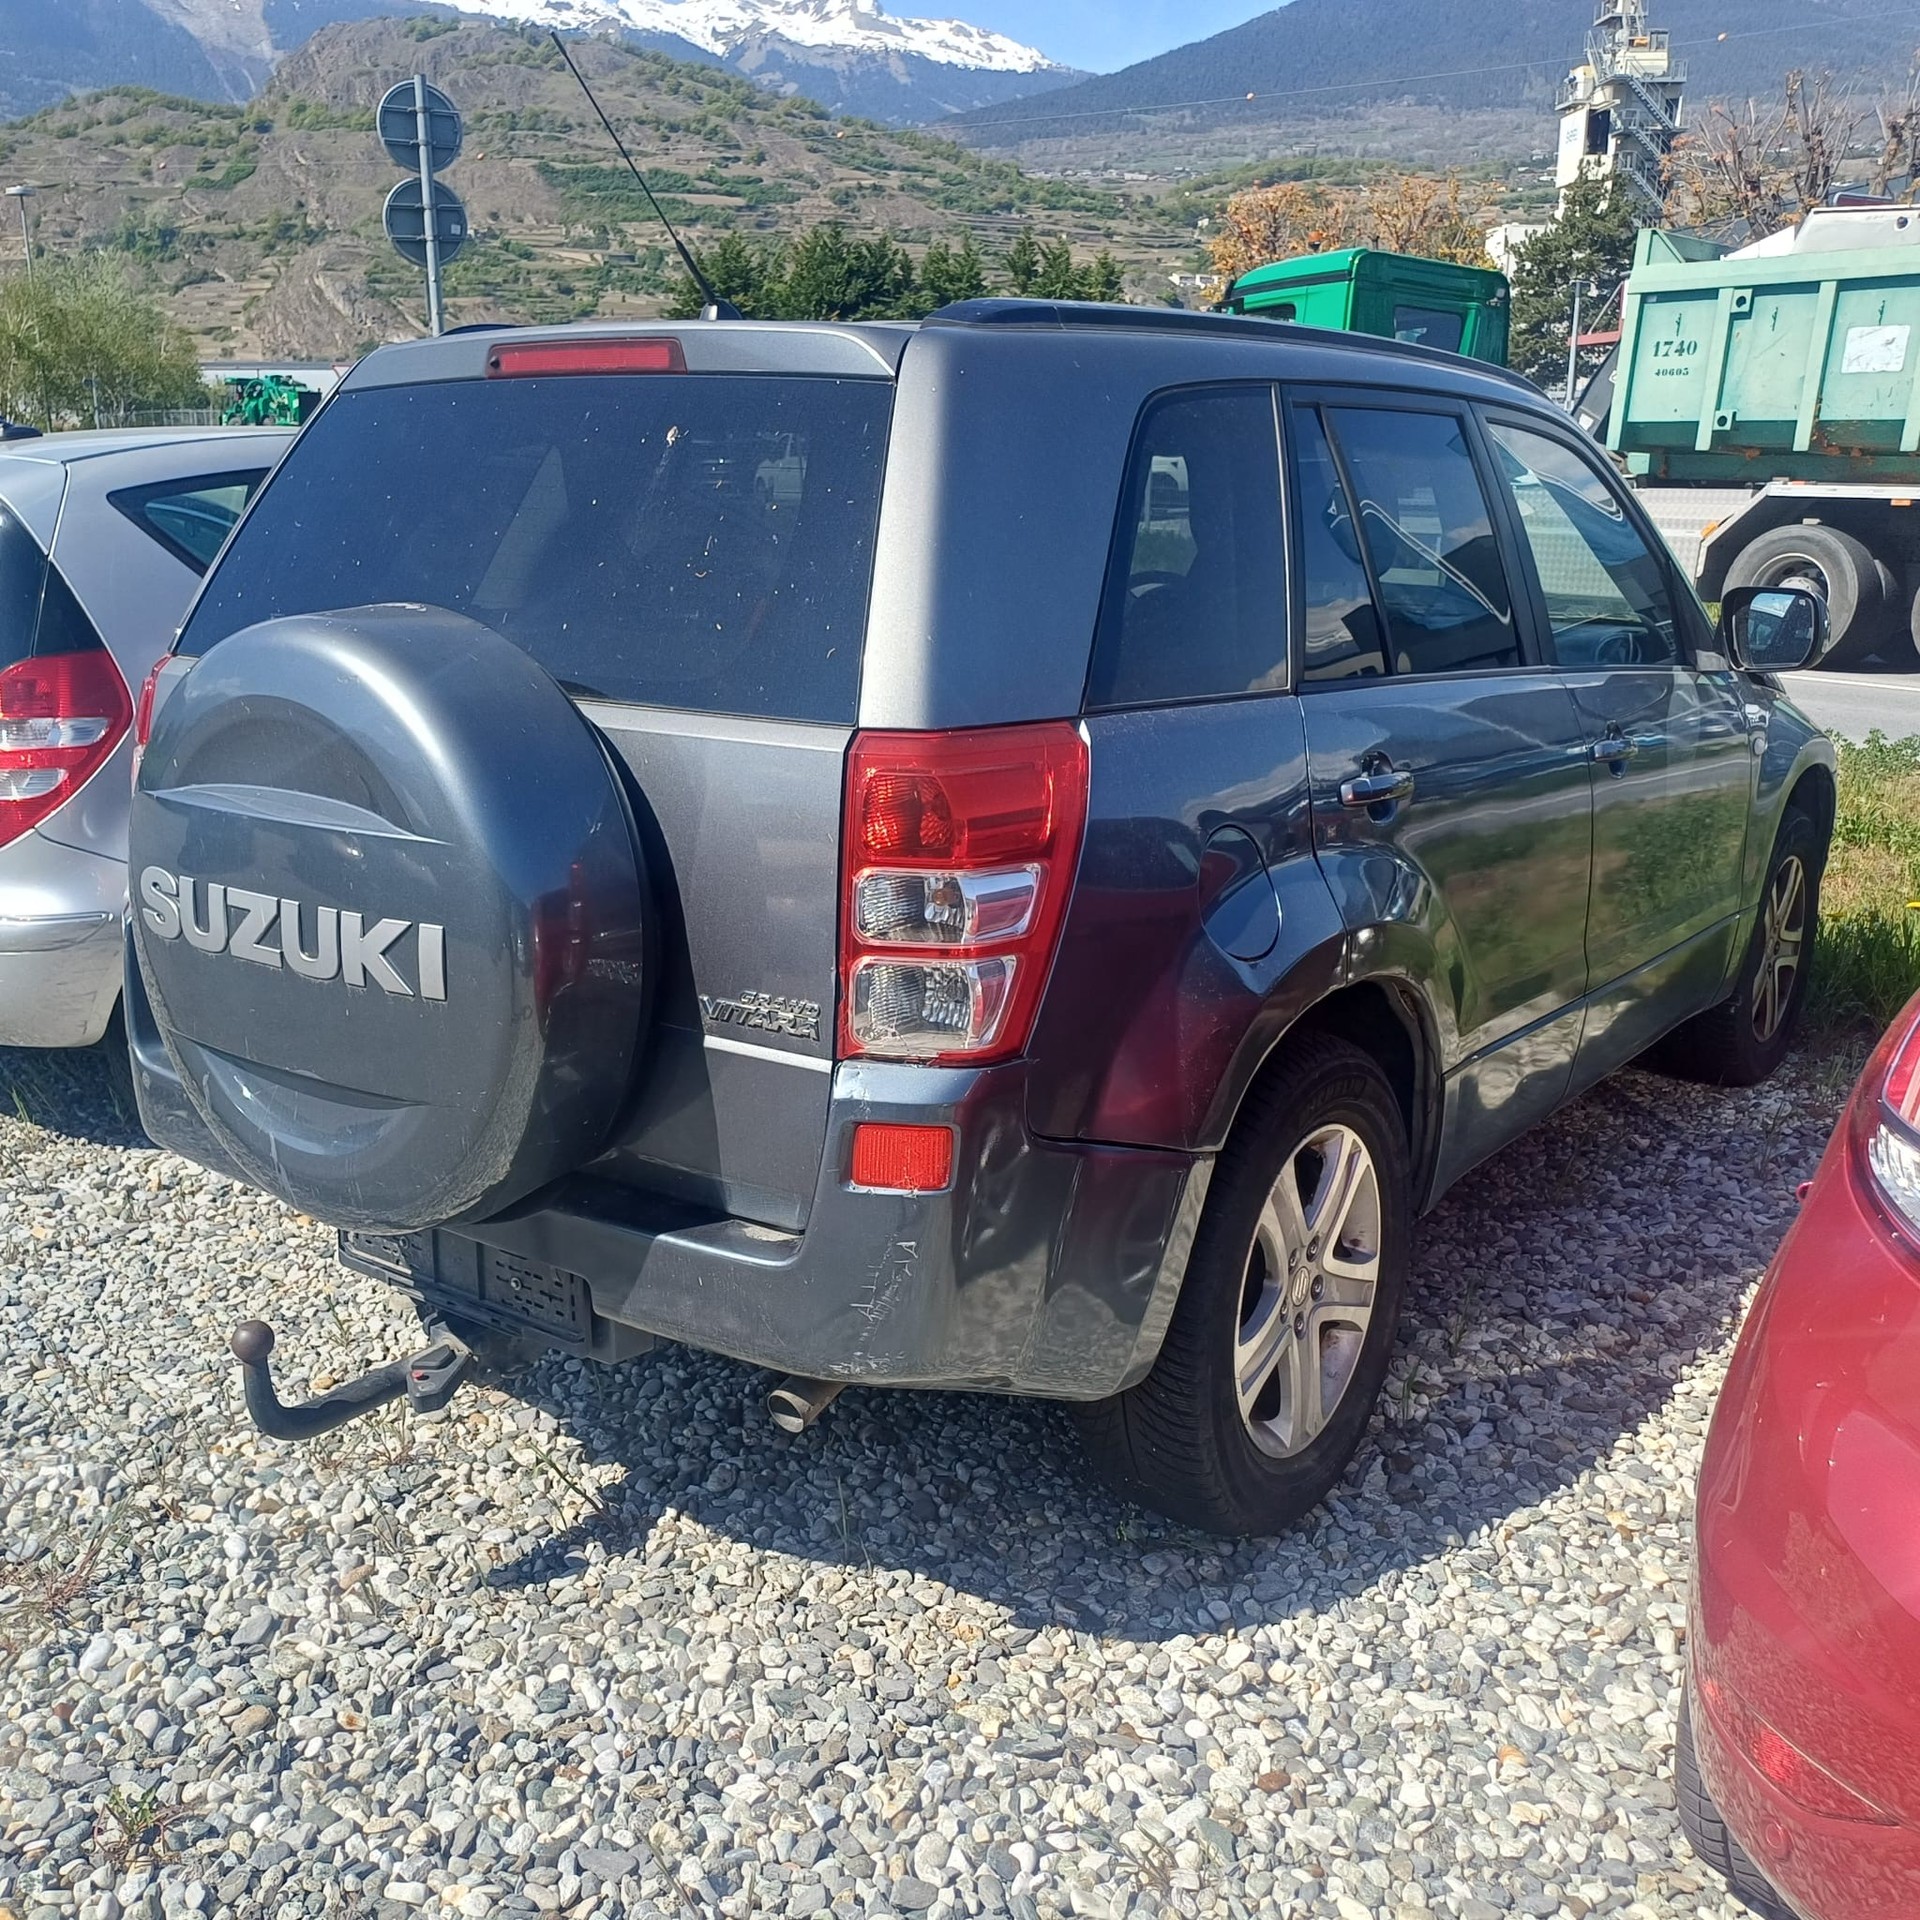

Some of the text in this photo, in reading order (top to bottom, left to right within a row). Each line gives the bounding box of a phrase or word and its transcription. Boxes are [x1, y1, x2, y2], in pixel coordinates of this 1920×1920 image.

[1653, 340, 1698, 357] 1740
[140, 865, 448, 1001] SUZUKI
[698, 995, 821, 1041] VITARA
[739, 990, 822, 1018] GRAND
